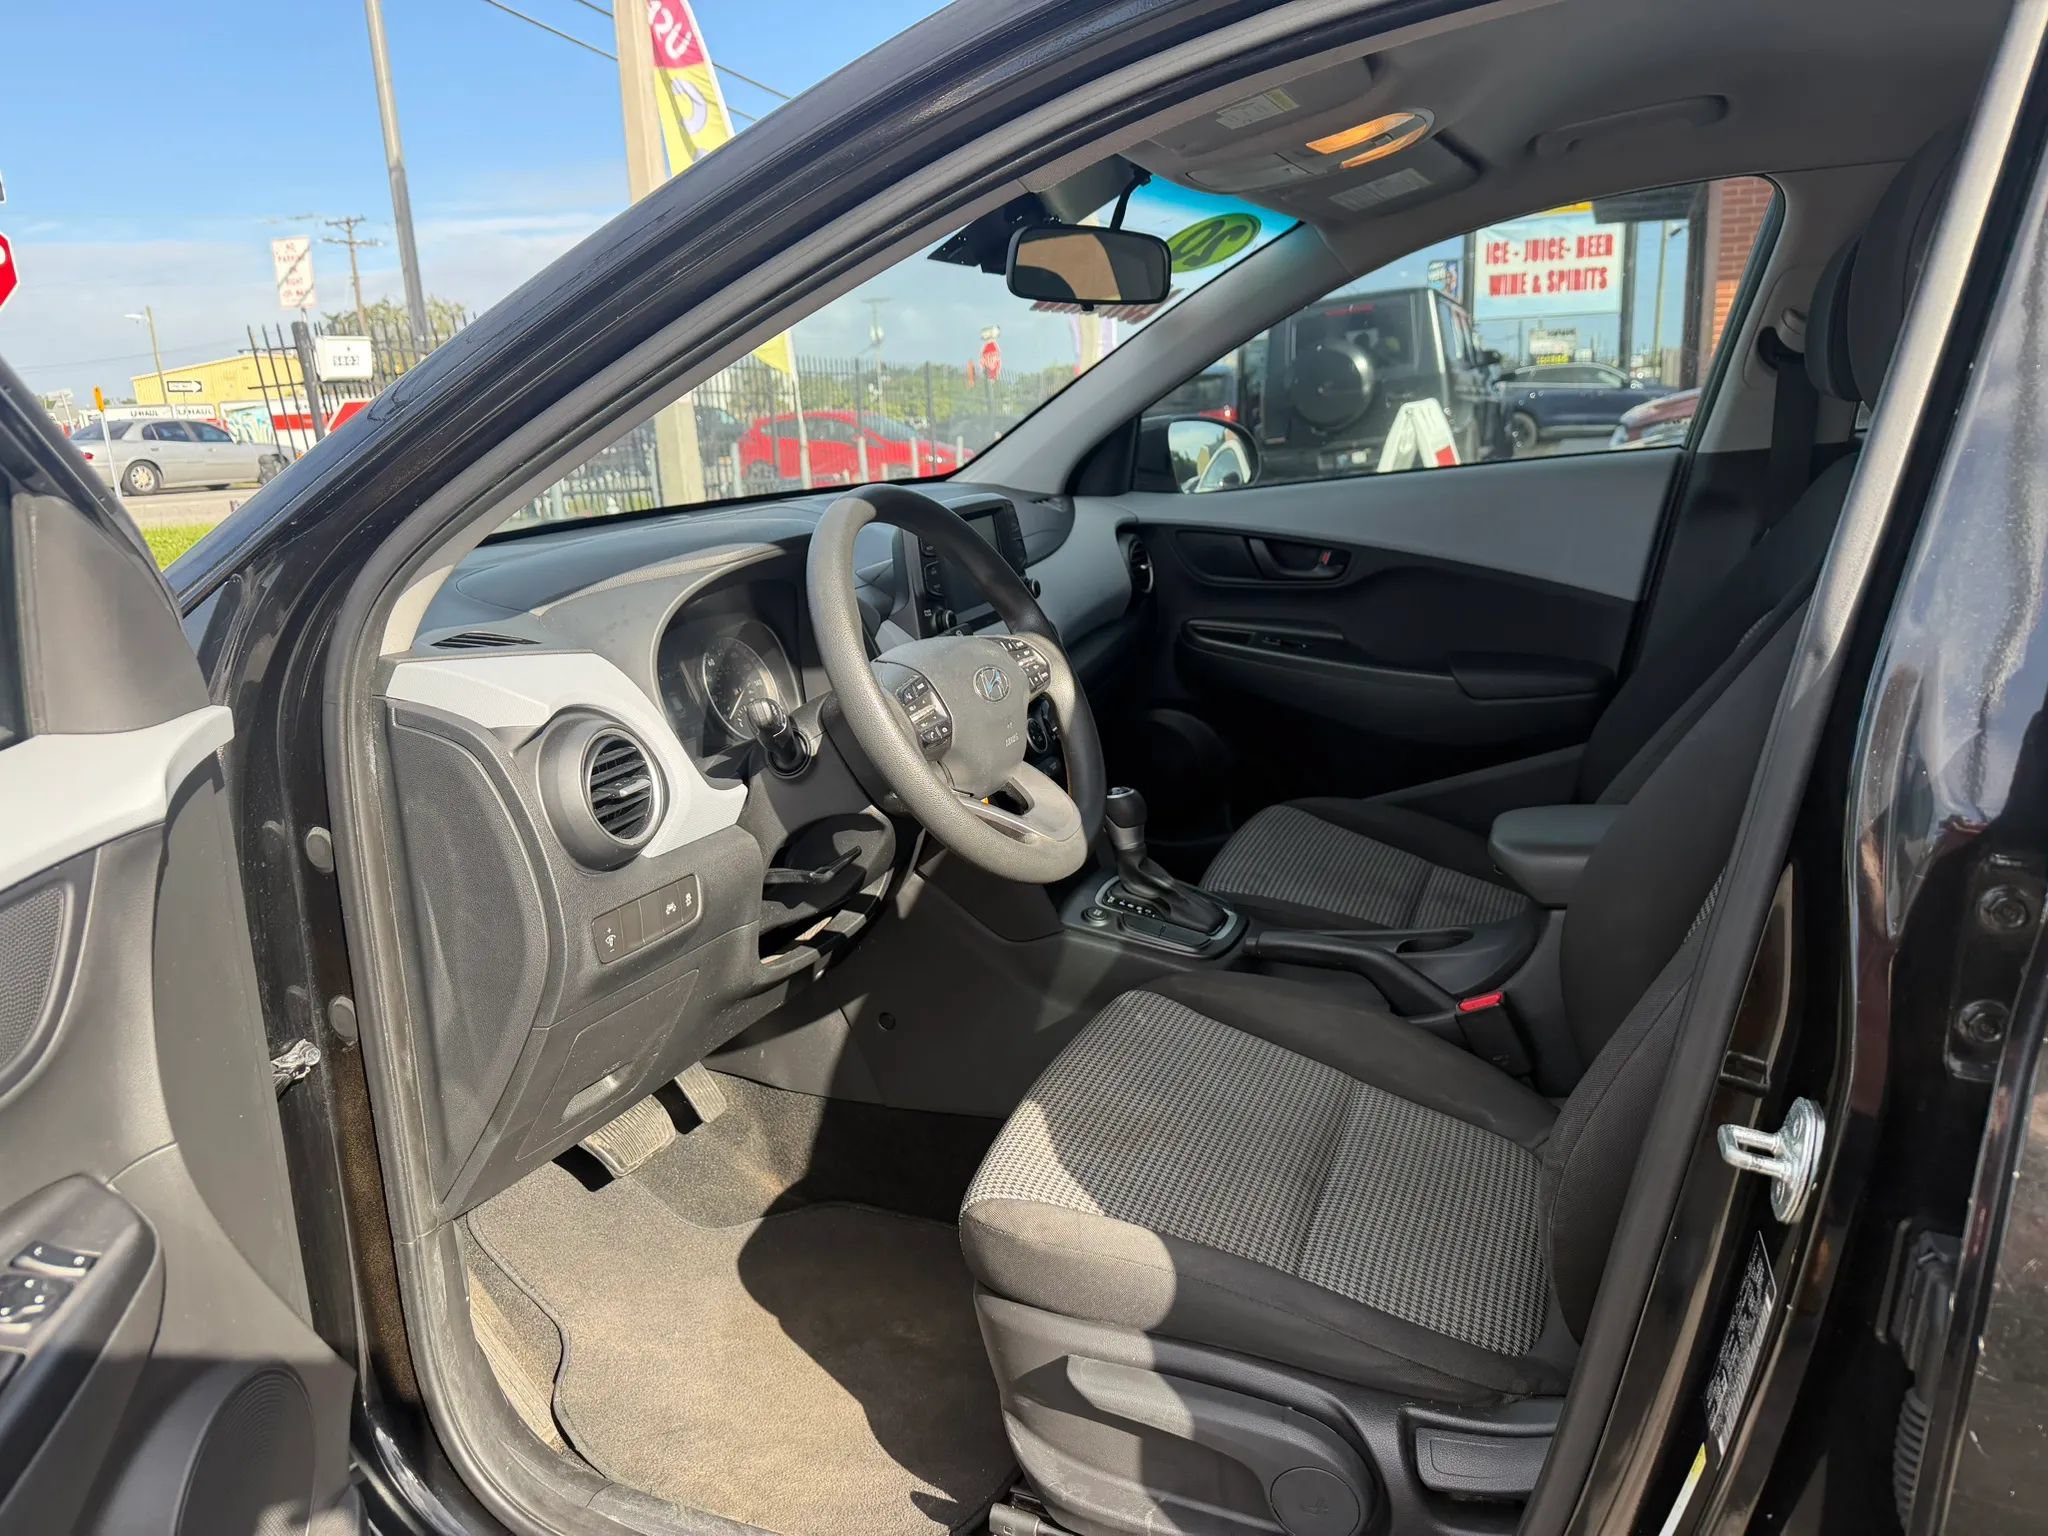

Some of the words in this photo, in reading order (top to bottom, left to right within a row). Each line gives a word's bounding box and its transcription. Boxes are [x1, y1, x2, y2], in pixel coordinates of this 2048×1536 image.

[1486, 241, 1509, 264] ICE
[1576, 234, 1613, 258] BEER
[1489, 272, 1528, 296] WINE
[1532, 275, 1541, 293] &
[1547, 267, 1608, 292] SPIRITS
